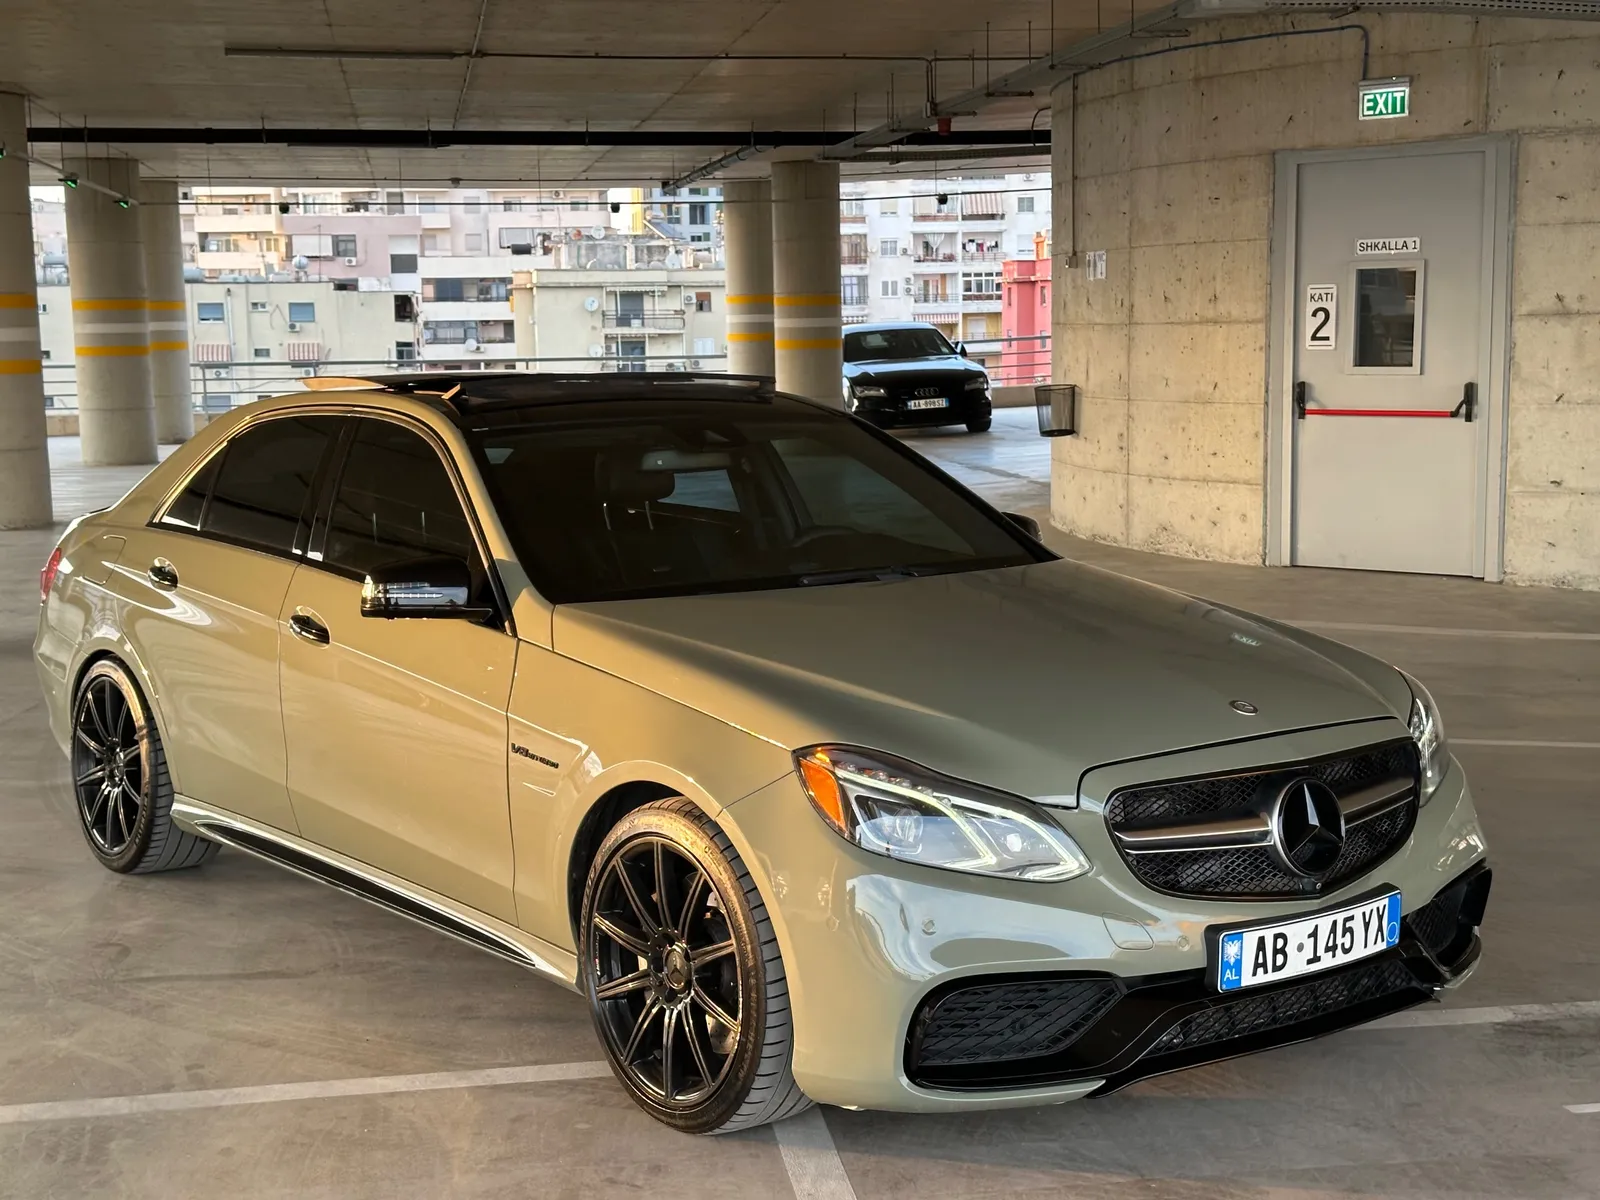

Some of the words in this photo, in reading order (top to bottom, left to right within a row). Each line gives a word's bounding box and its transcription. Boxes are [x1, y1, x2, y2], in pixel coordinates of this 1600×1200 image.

[1363, 92, 1405, 116] EXIT
[1358, 241, 1408, 252] SHKALLA
[1411, 240, 1418, 250] 1
[1309, 292, 1334, 303] KATI
[1310, 306, 1331, 341] 2
[1252, 932, 1288, 977] AB
[1306, 914, 1355, 966] 145
[1362, 904, 1387, 949] YX
[1223, 968, 1240, 981] AL
